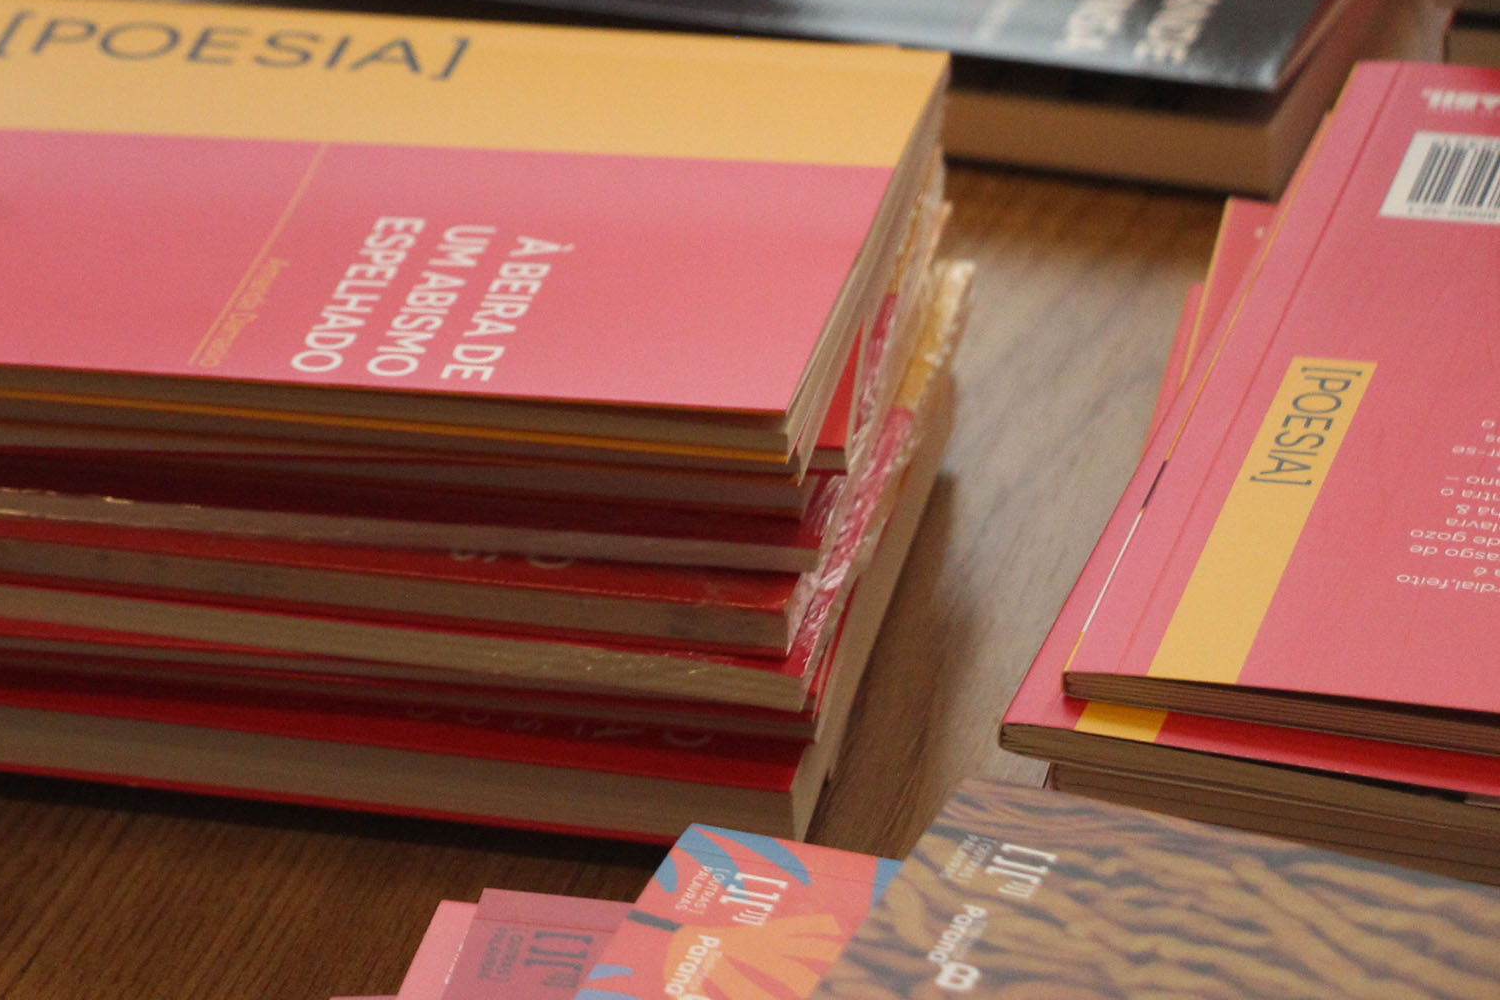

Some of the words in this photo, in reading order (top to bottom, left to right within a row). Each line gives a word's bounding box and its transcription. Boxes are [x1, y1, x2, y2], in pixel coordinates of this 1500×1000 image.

[429, 224, 497, 268] UM
[510, 235, 574, 257] À
[290, 216, 426, 373] ESPELHADO
[462, 262, 552, 338] BEIRA
[366, 270, 467, 377] ABISMO
[440, 343, 506, 382] DE
[1250, 366, 1362, 486] [POESIA]
[1440, 487, 1455, 497] o
[1409, 529, 1467, 543] gozo
[1445, 517, 1500, 533] lavra
[1409, 544, 1439, 557] de
[1444, 547, 1500, 563] asgo
